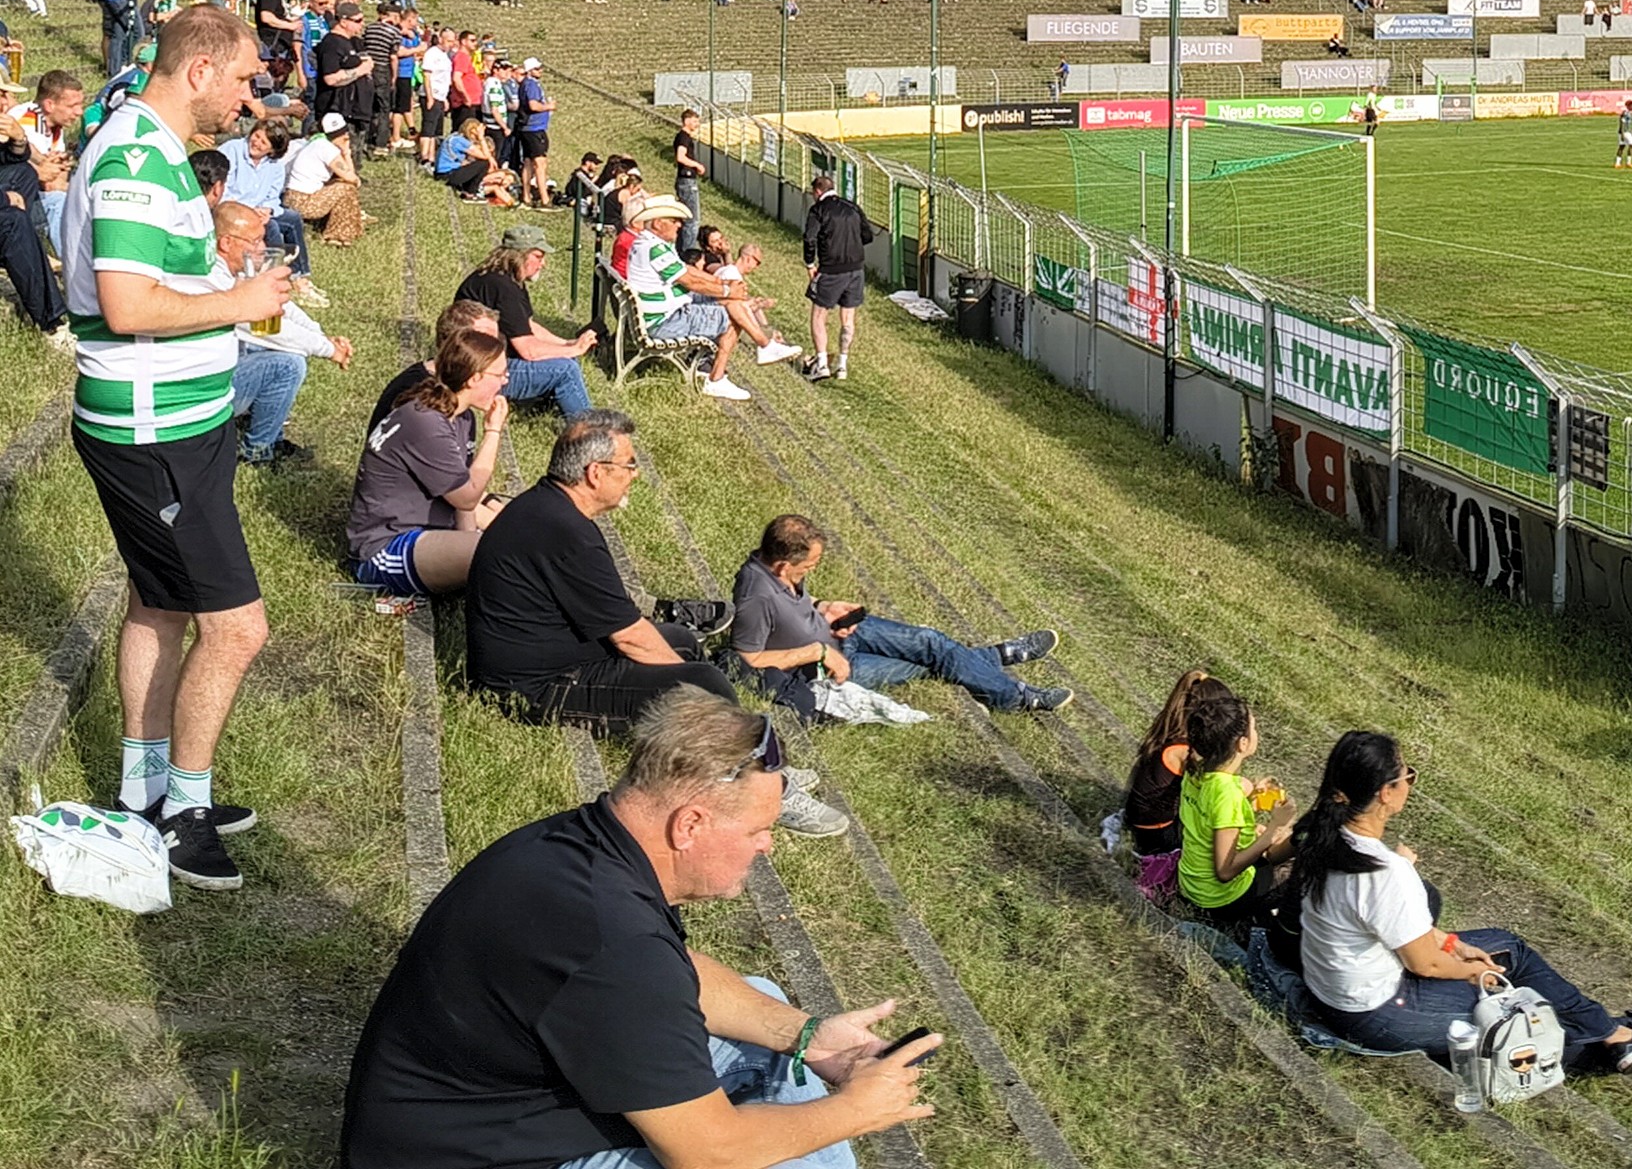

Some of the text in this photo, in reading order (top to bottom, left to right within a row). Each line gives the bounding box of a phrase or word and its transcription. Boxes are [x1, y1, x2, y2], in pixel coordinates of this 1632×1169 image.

[1046, 21, 1120, 35] FLIEGENDE
[1181, 42, 1234, 56] BAUTEN
[1299, 66, 1374, 80] HANNOVER
[979, 109, 1025, 125] publish!
[1106, 107, 1153, 122] tabmag
[1218, 105, 1255, 119] Neue
[1256, 103, 1305, 118] Presse
